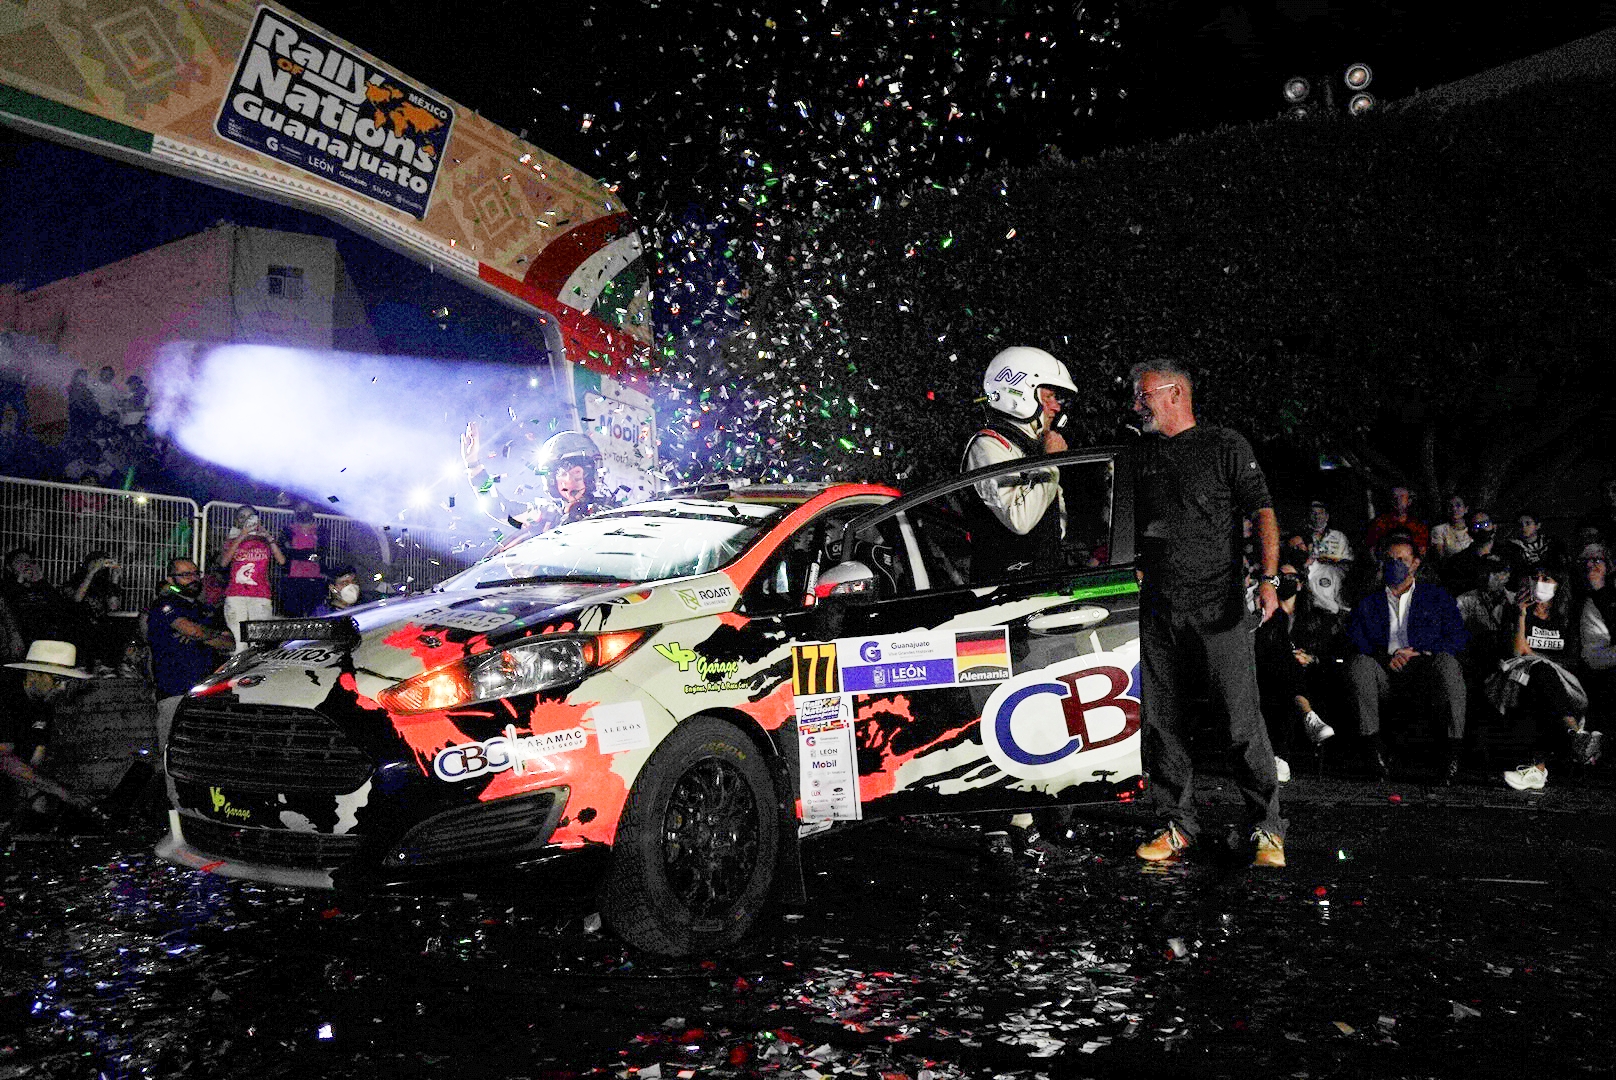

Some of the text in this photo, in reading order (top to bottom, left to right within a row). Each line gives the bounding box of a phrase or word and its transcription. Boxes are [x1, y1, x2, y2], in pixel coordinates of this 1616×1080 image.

[255, 14, 386, 105] Rally
[239, 44, 437, 173] Nations
[232, 92, 428, 194] Guanajuato
[308, 155, 334, 174] LEÓN
[699, 586, 732, 600] ROART
[890, 640, 930, 651] Guanajuato
[697, 656, 739, 682] Garage
[892, 664, 927, 680] LEÓN
[959, 669, 1009, 682] Alemania
[994, 660, 1141, 765] CB
[438, 740, 510, 777] CBG
[812, 760, 837, 769] Mobil
[224, 802, 251, 821] Garage
